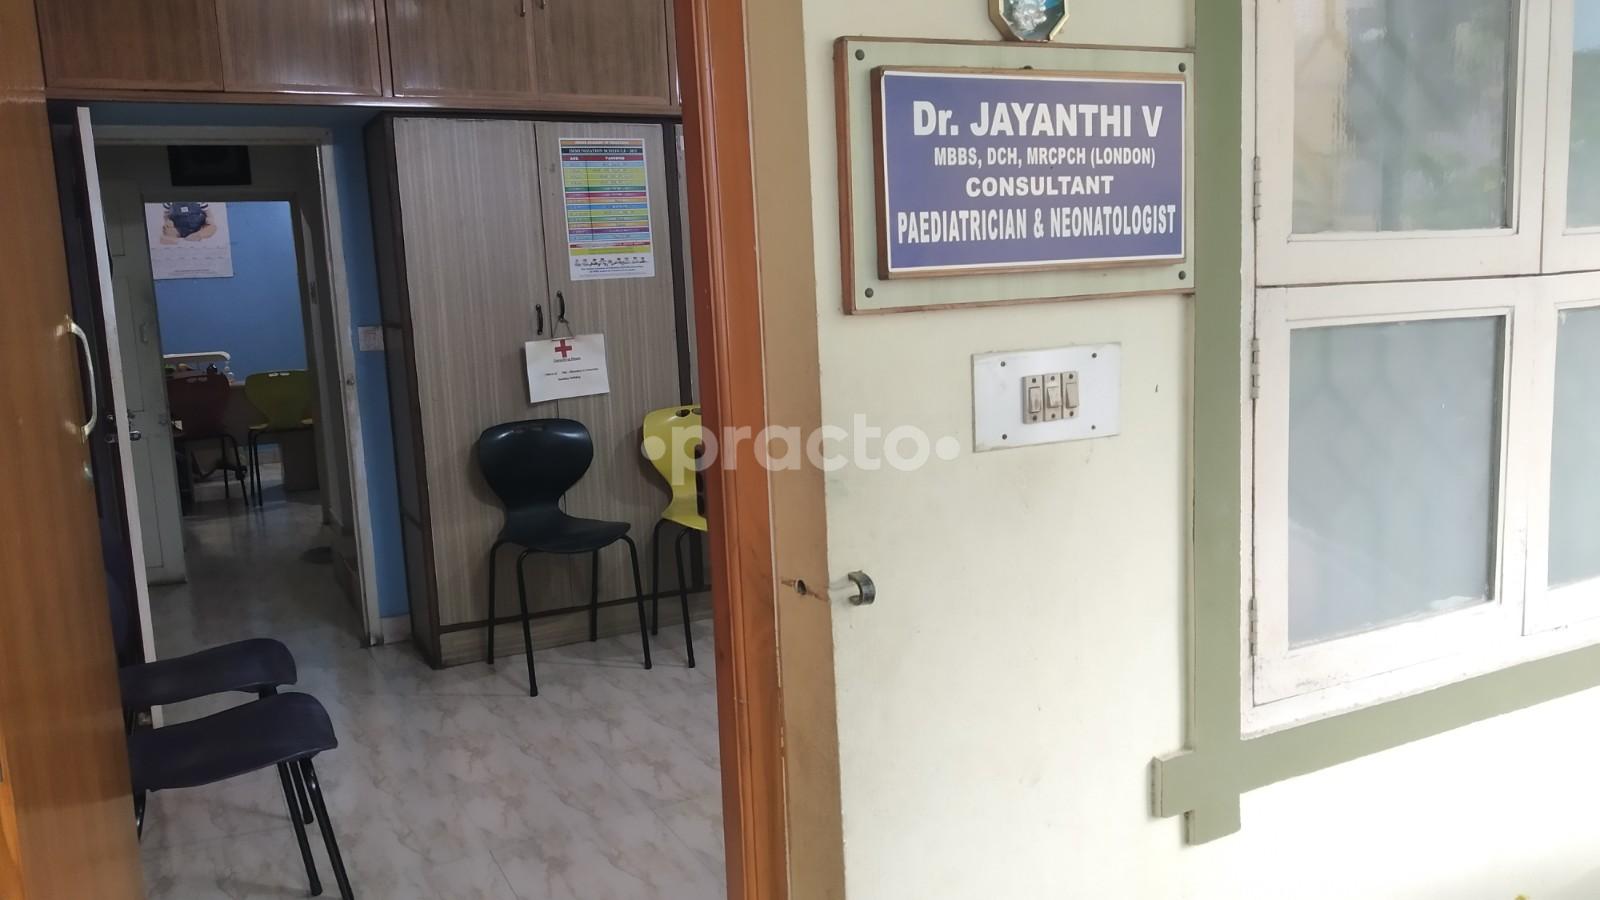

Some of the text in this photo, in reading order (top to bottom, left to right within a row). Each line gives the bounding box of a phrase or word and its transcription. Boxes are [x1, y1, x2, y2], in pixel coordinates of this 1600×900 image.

[912, 100, 1163, 137] Dr. JAYANTHI V
[934, 146, 1156, 169] MBBS, DCH, MRCPCH (LONDON)
[965, 175, 1114, 197] CONSULTANT
[897, 204, 1176, 244] PAEDIATRICIAN & NEONATOLOGIST
